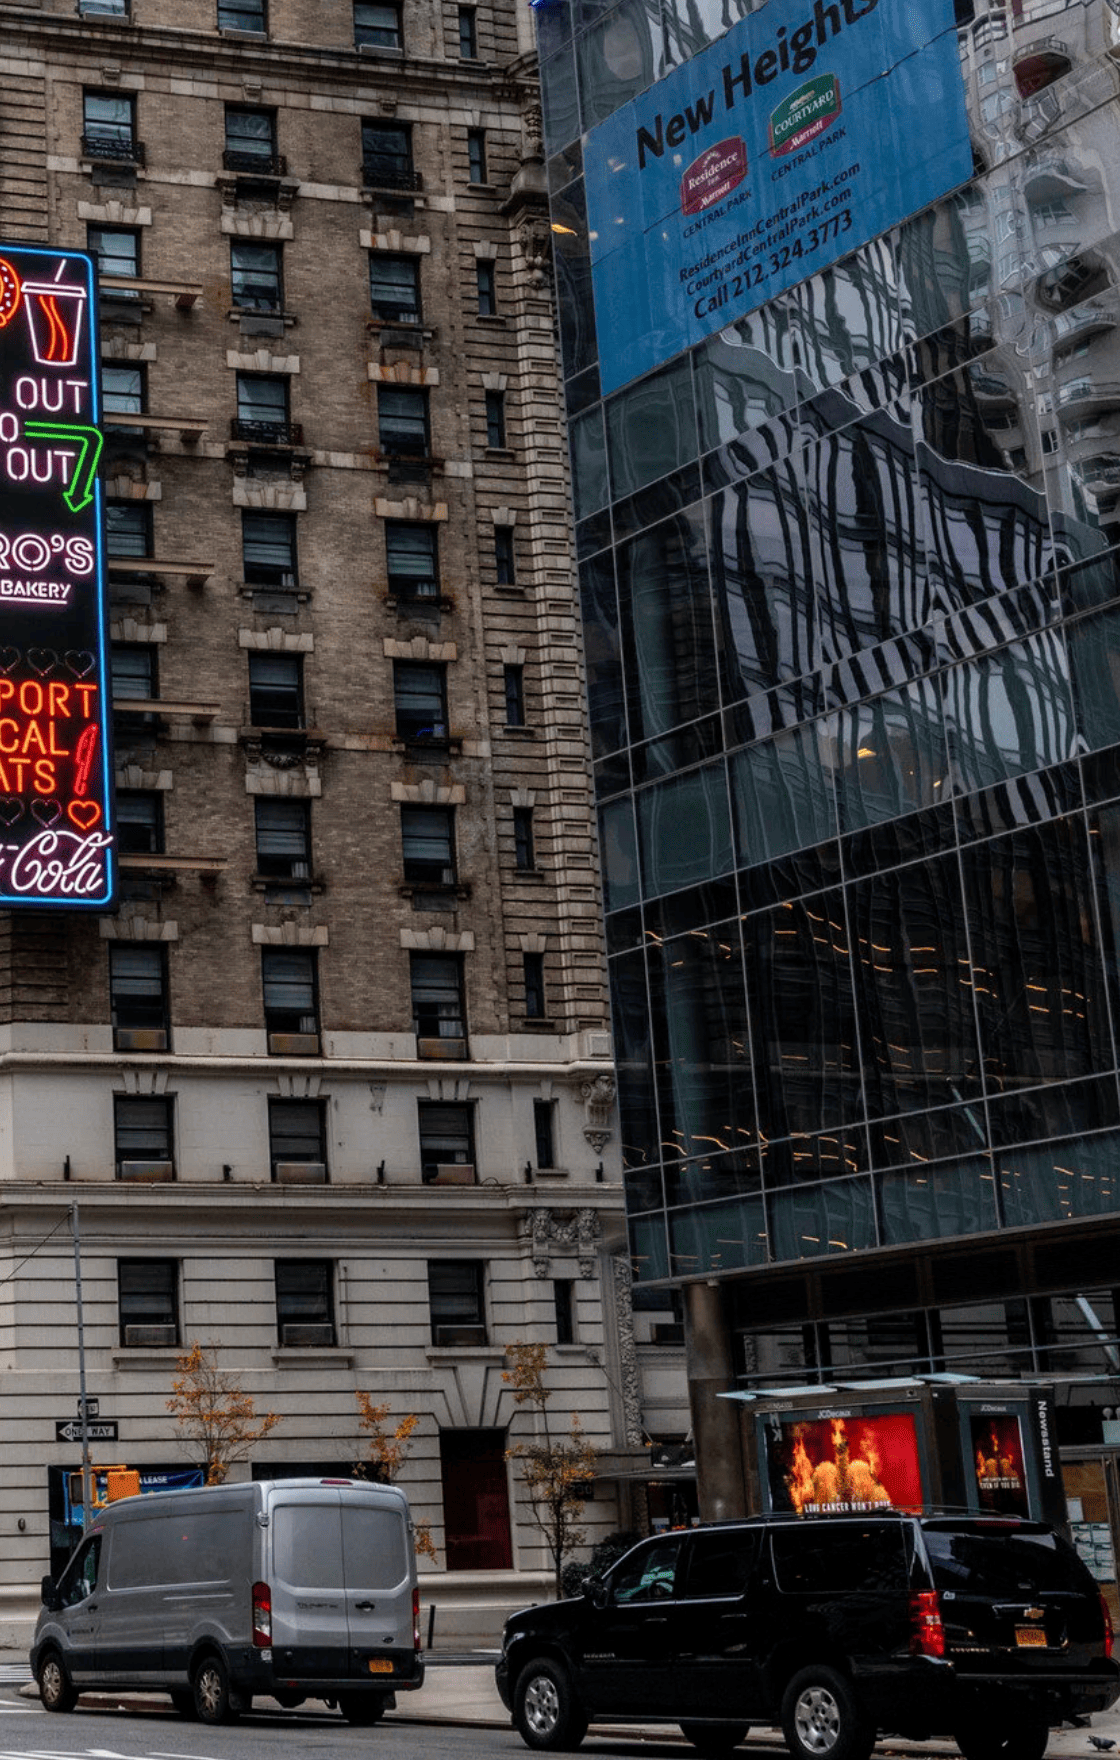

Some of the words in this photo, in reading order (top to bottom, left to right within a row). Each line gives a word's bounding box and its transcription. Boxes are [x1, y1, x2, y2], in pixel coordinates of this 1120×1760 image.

[636, 90, 715, 170] New
[774, 90, 835, 136] COURTYARD
[789, 118, 824, 150] Marriott
[688, 151, 738, 190] Residence
[770, 147, 818, 182] CENTRAL
[818, 126, 847, 150] PARK
[683, 206, 727, 239] CENTRAL
[726, 190, 752, 210] PARK
[699, 181, 731, 209] Marriott
[680, 162, 861, 282] ResidenceInnCentralPark.com
[686, 187, 853, 296] CourtyardCentralPark.com
[694, 284, 729, 319] Call
[732, 208, 853, 298] 212.324.3773
[16, 377, 88, 413] OUT
[7, 447, 76, 484] OUT
[0, 579, 71, 598] BAKERY
[91, 1427, 110, 1436] WAY
[1038, 1401, 1055, 1477] Newsstand
[143, 1475, 168, 1485] LEASE
